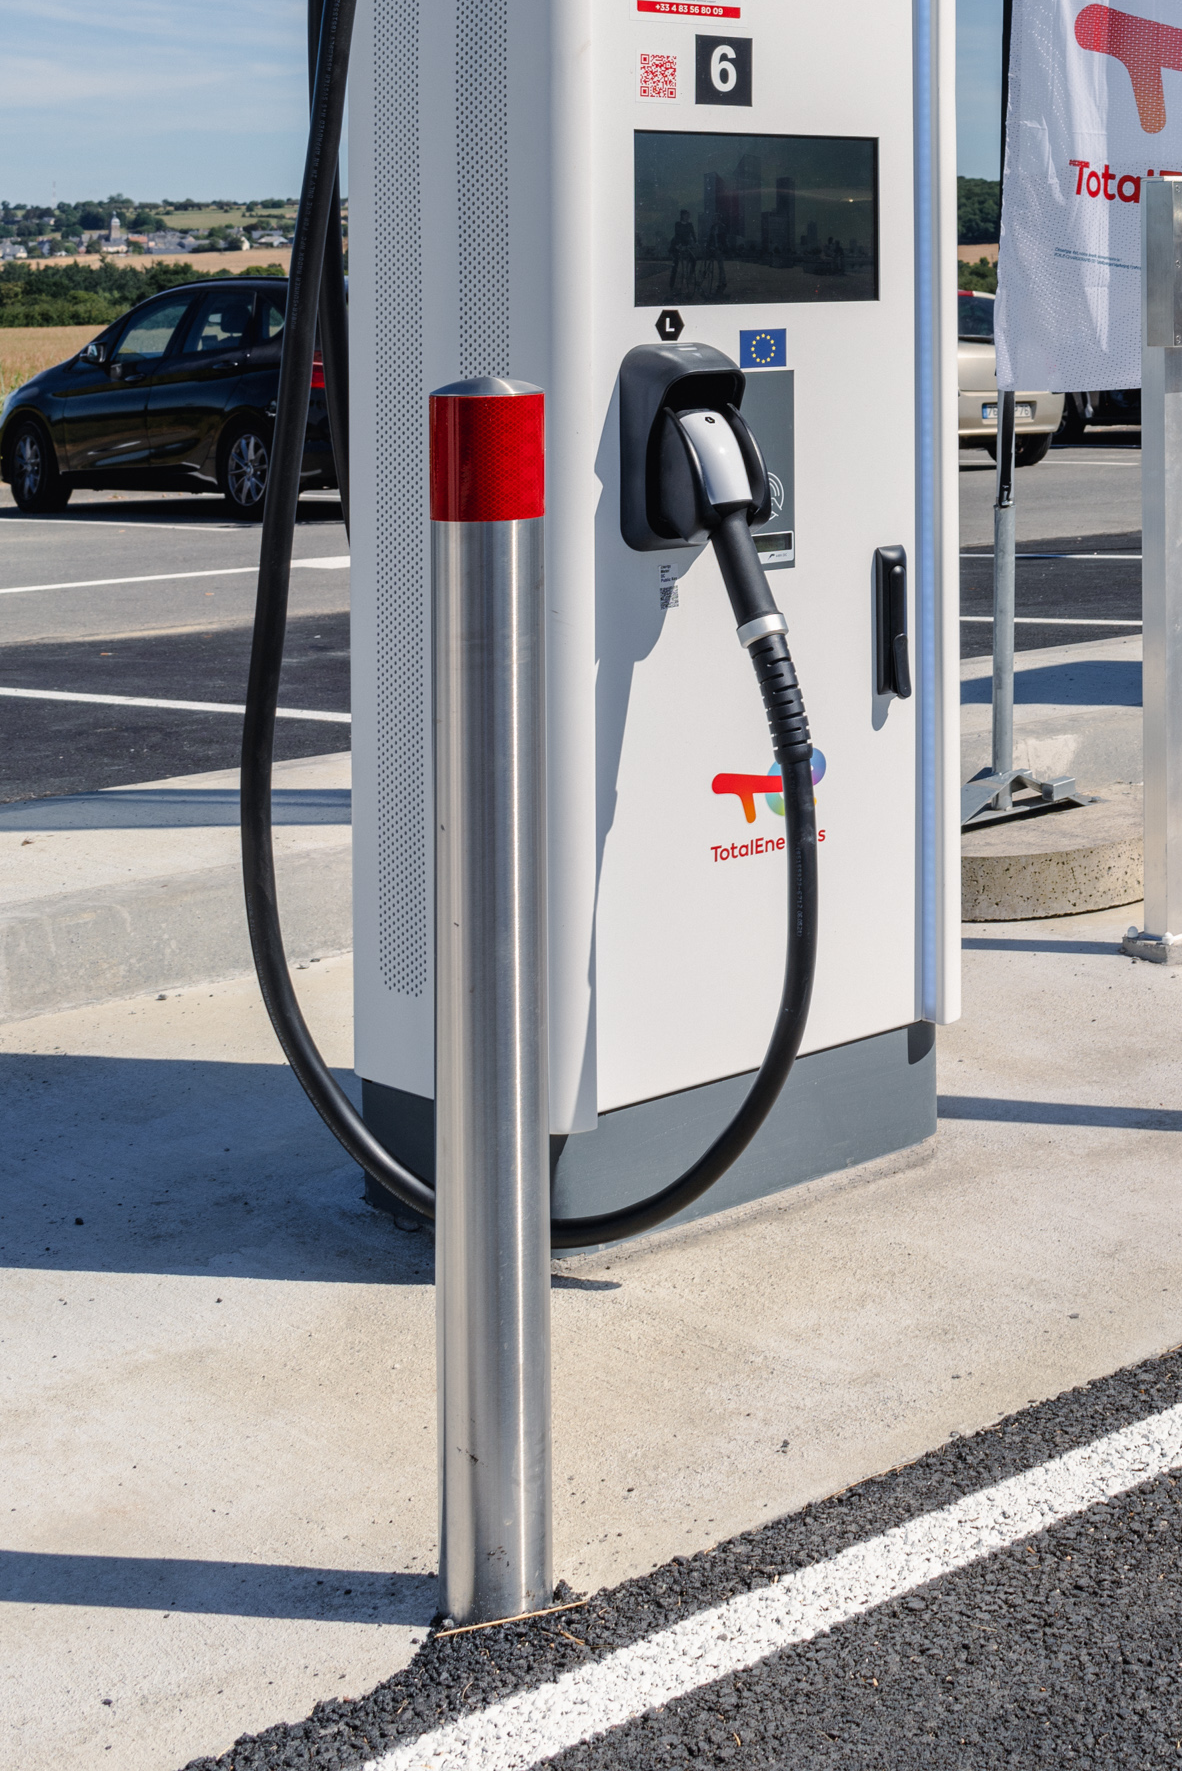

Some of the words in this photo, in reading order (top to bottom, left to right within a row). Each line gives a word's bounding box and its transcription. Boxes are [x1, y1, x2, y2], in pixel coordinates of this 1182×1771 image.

[655, 3, 670, 11] +33
[671, 4, 677, 12] 4
[678, 5, 688, 13] 83
[689, 6, 699, 14] 56
[701, 6, 711, 14] 80
[712, 7, 723, 15] 09
[710, 44, 737, 92] 6
[291, 277, 301, 329] HUBER+SUHNER
[296, 253, 305, 274] RADOX
[302, 218, 310, 231] FOR
[315, 120, 326, 155] APPROVED
[322, 74, 331, 100] SYSTEM
[665, 317, 675, 332] L
[710, 829, 826, 862] TotalEnes
